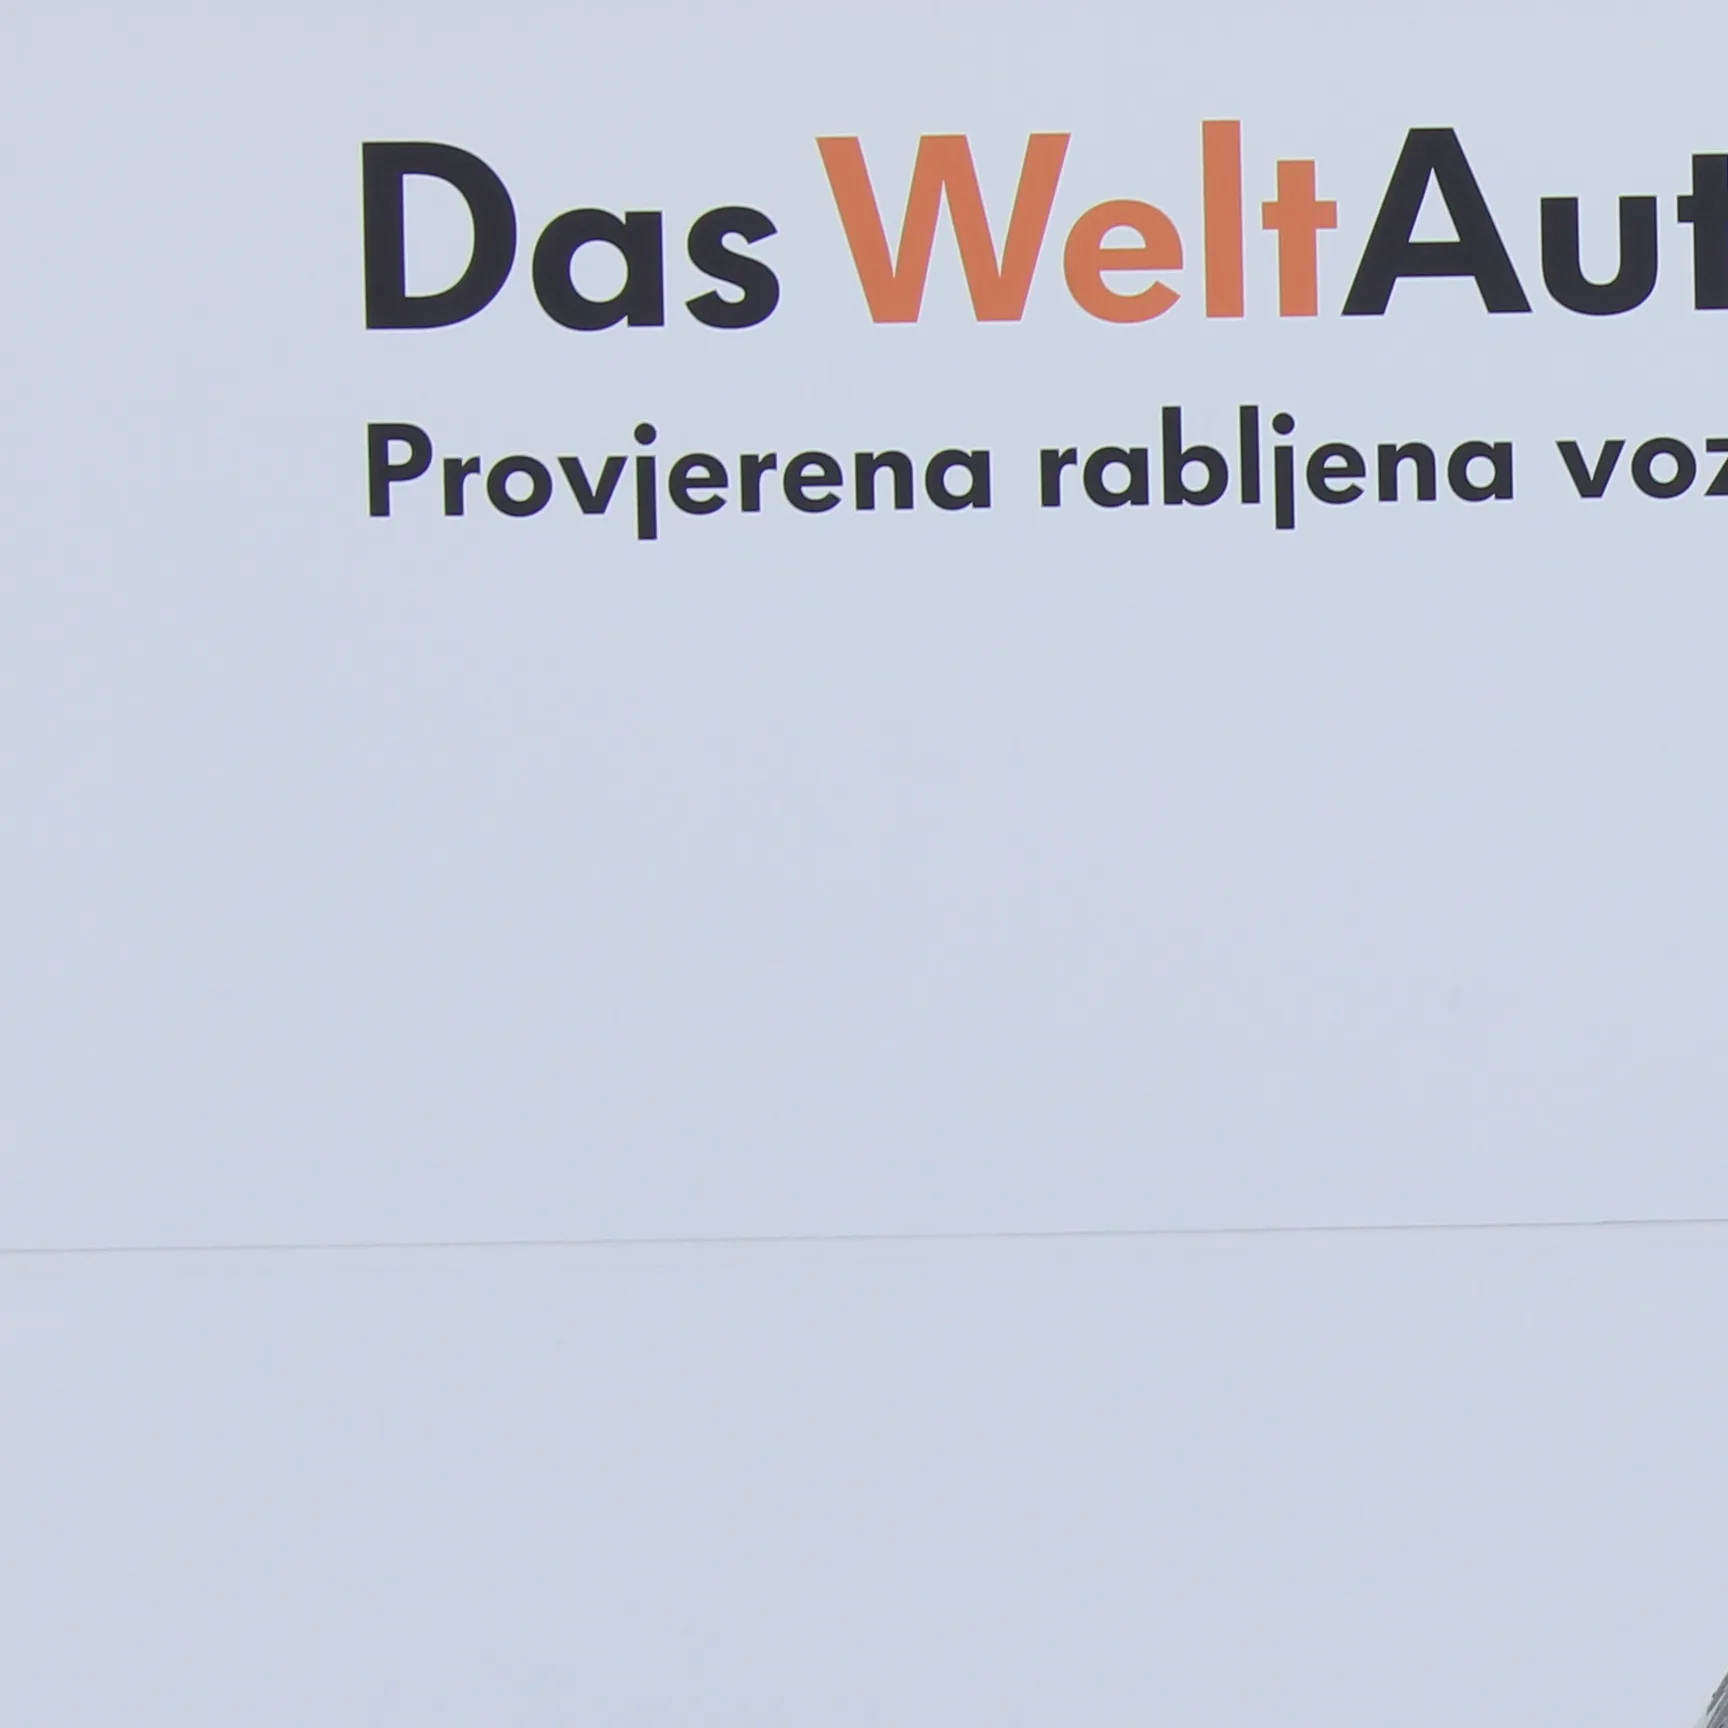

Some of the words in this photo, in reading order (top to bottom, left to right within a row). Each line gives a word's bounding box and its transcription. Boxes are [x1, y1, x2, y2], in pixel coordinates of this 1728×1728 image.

[362, 142, 780, 331] Das
[368, 423, 991, 541] Provjerena
[1040, 405, 1514, 530] rabljena
